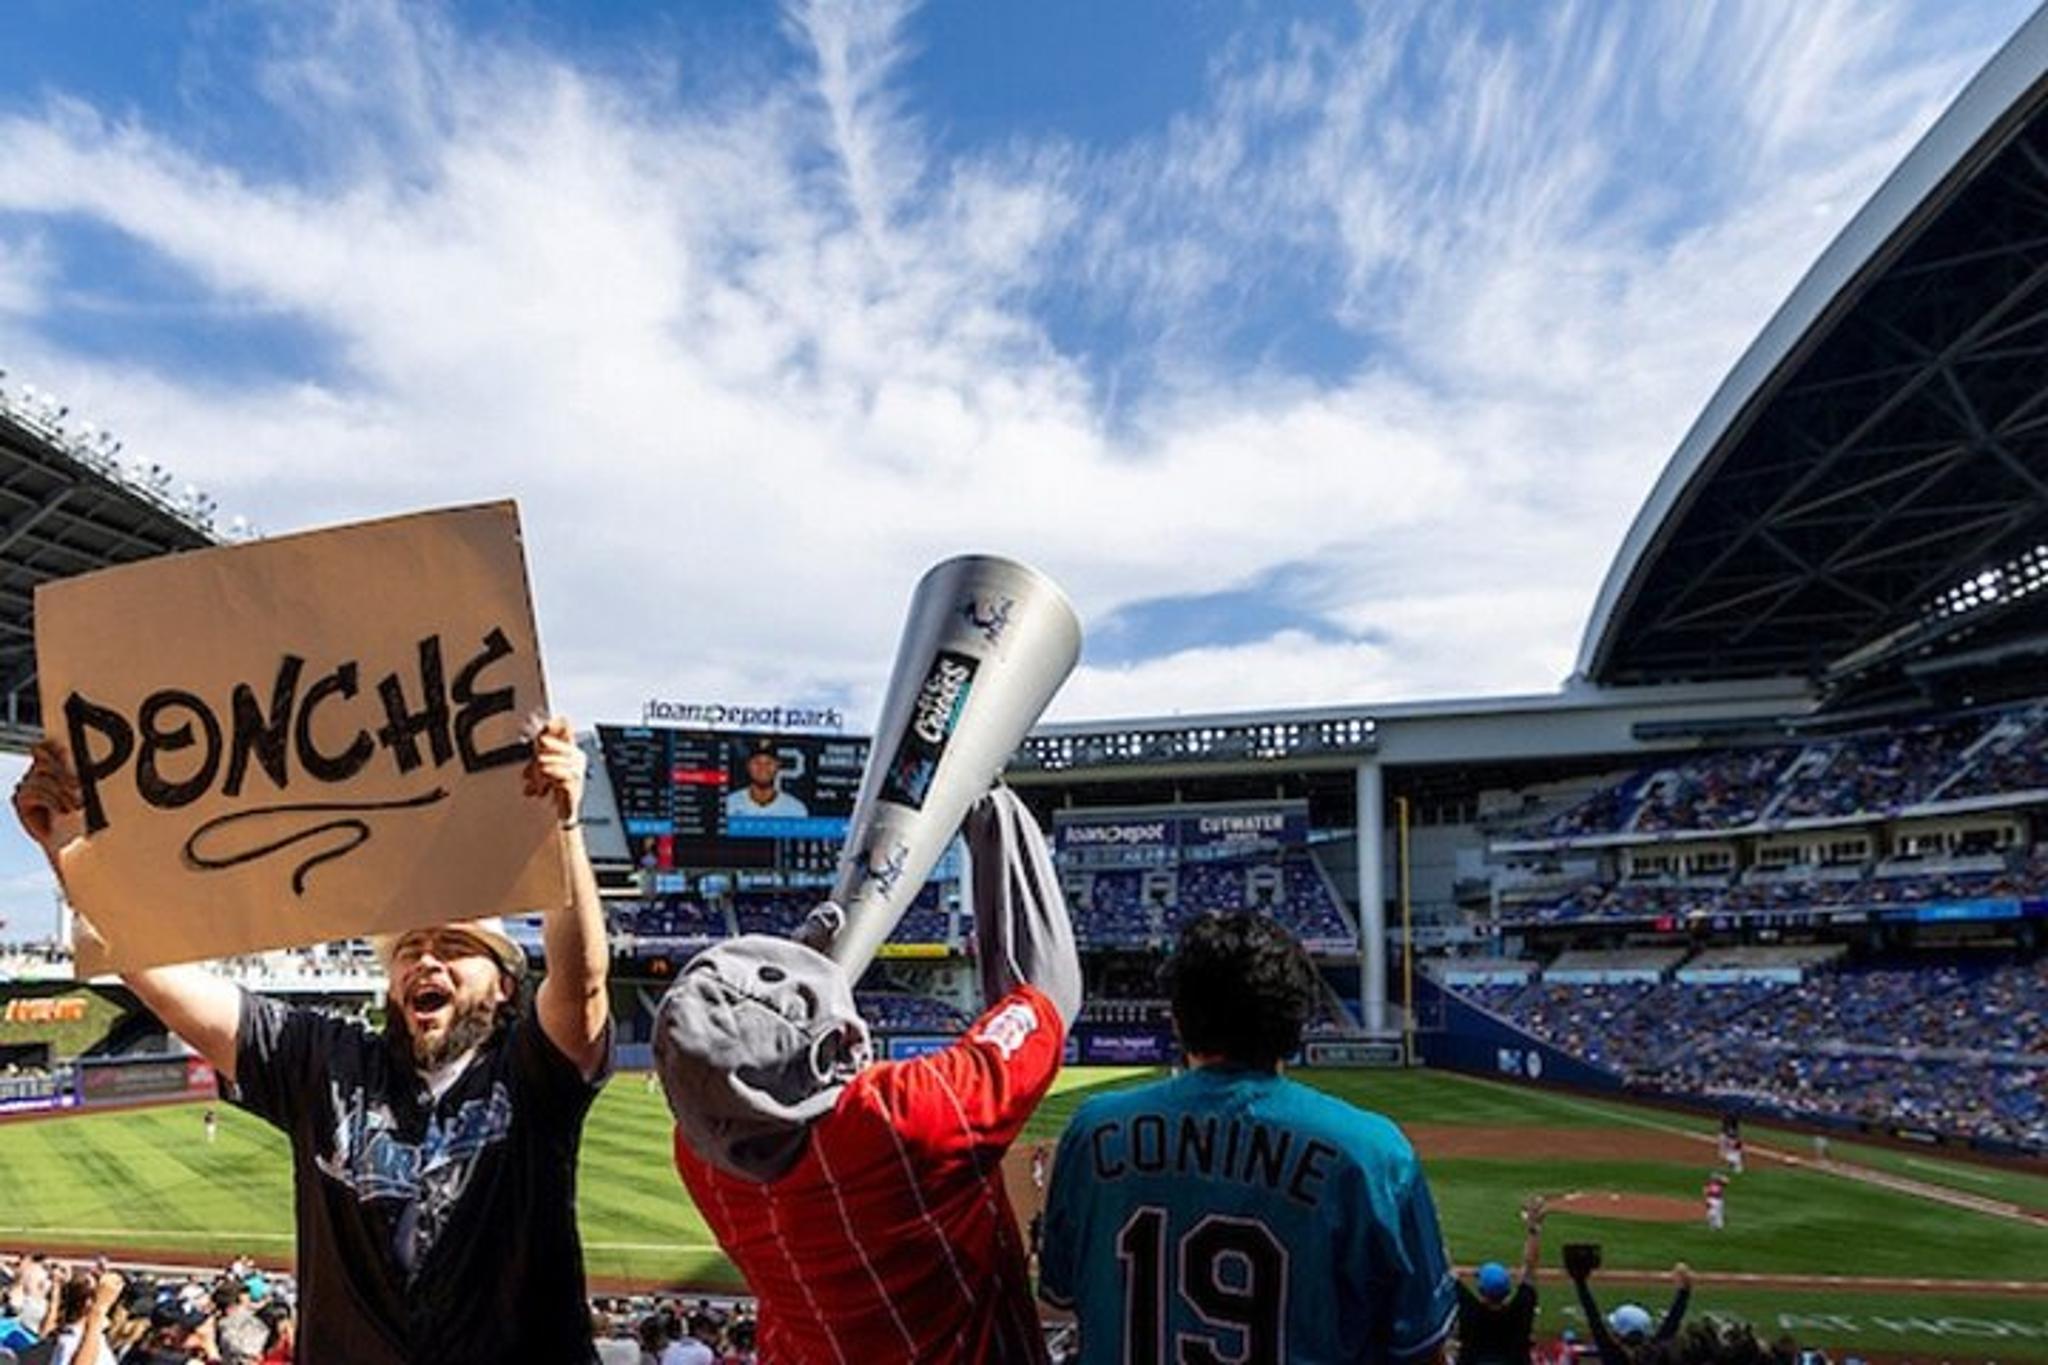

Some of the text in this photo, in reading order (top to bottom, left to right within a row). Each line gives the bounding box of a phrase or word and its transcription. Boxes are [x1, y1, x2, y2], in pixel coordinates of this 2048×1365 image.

[64, 627, 535, 835] PONCHE
[785, 707, 841, 729] park
[1090, 1113, 1341, 1206] CONINE
[1116, 1205, 1289, 1365] 19
